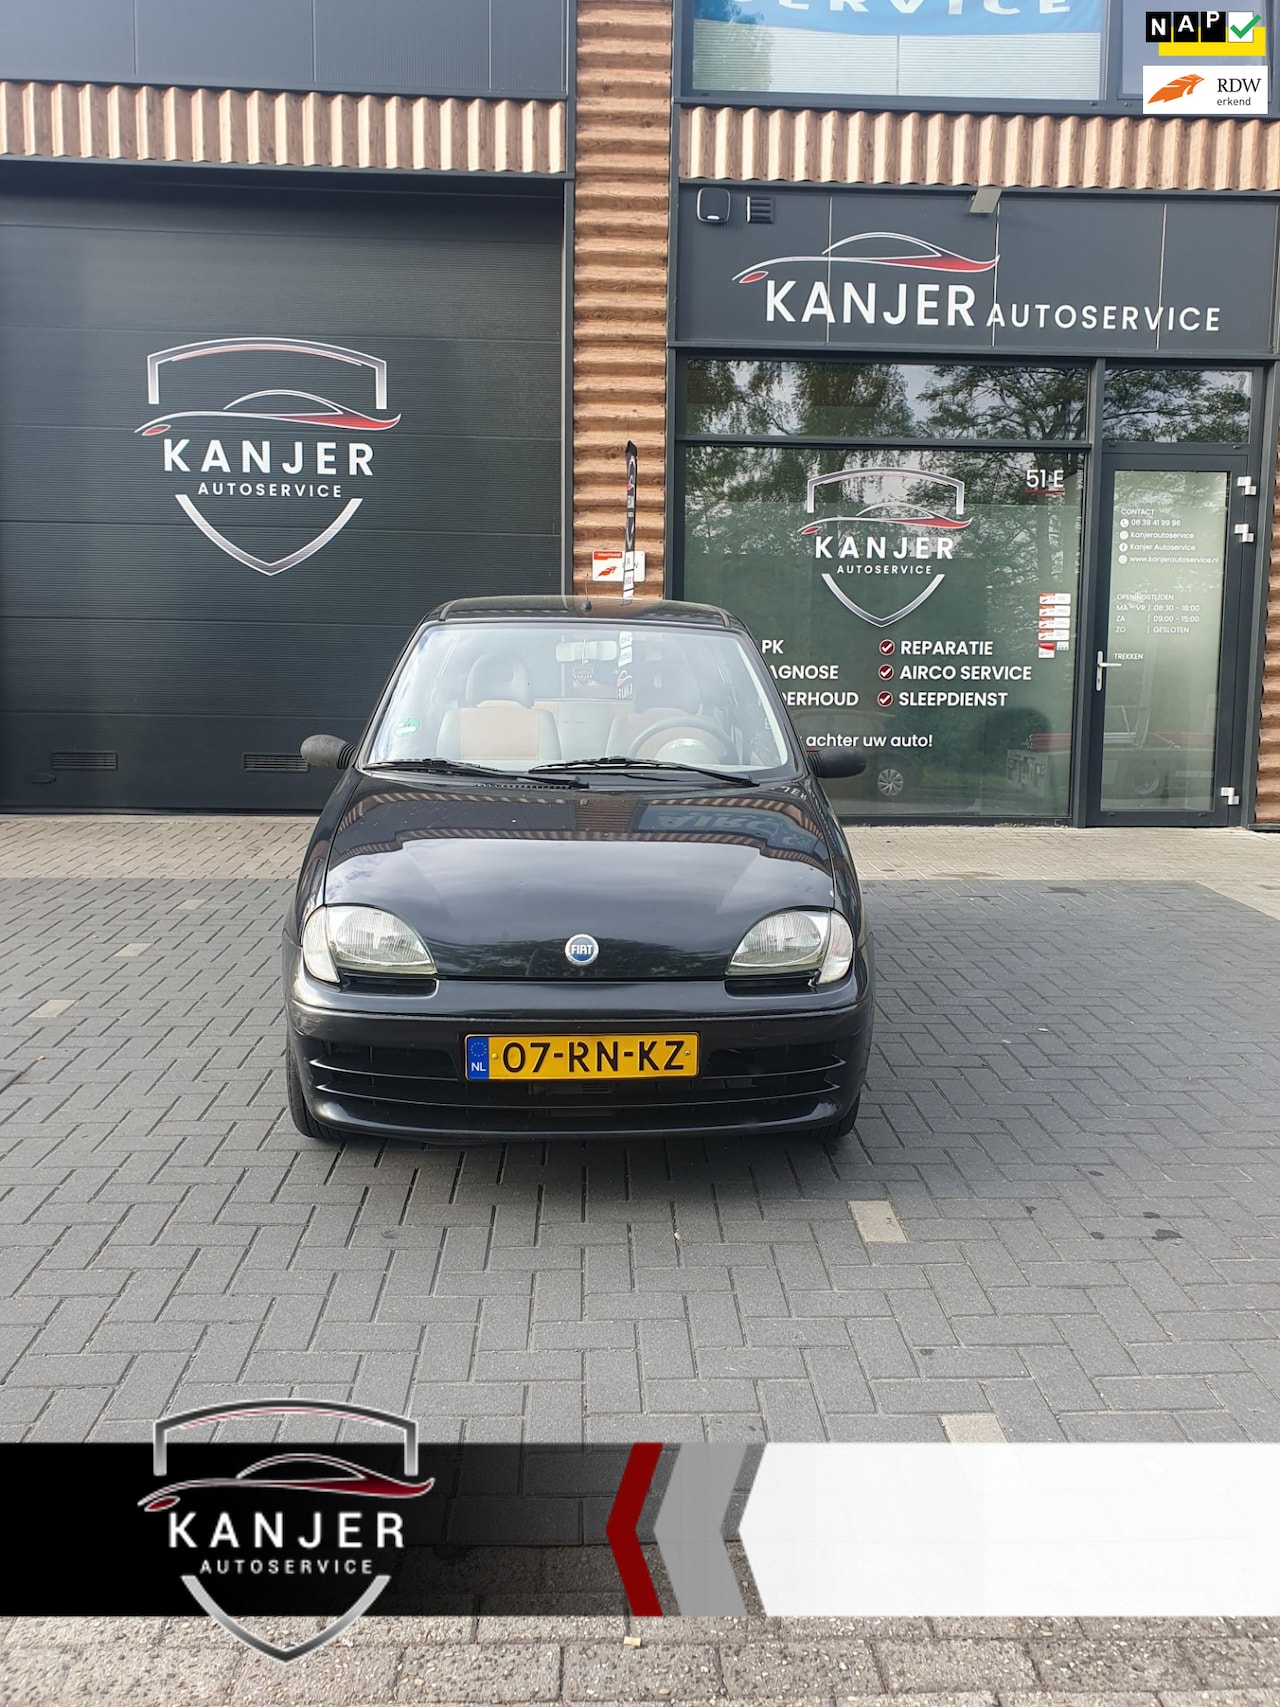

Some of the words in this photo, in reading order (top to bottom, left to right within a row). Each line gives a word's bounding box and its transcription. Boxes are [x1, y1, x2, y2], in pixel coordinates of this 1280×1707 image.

[766, 280, 976, 327] KANJER
[986, 303, 1220, 331] AUTOSERVICE
[163, 438, 374, 476] KANJER
[198, 482, 342, 498] AUTOSERVICE
[1130, 531, 1195, 539] Kanjerautoservice
[815, 536, 953, 559] KANJER
[1130, 543, 1152, 552] Kanjer
[836, 565, 932, 574] AUTOSERVICE
[900, 641, 993, 655] REPARATIE
[1114, 652, 1144, 660] TREKKEN
[899, 666, 956, 680] AIRCO
[960, 666, 1032, 680] SERVICE
[782, 692, 859, 706] ERHOUD
[898, 692, 1008, 706] SLEEPDIENST
[806, 733, 859, 747] achter
[863, 736, 887, 747] uw
[890, 734, 933, 747] auto!
[571, 944, 593, 955] FIAT
[502, 1040, 685, 1073] 07-RN-KZ
[471, 1062, 487, 1072] NL
